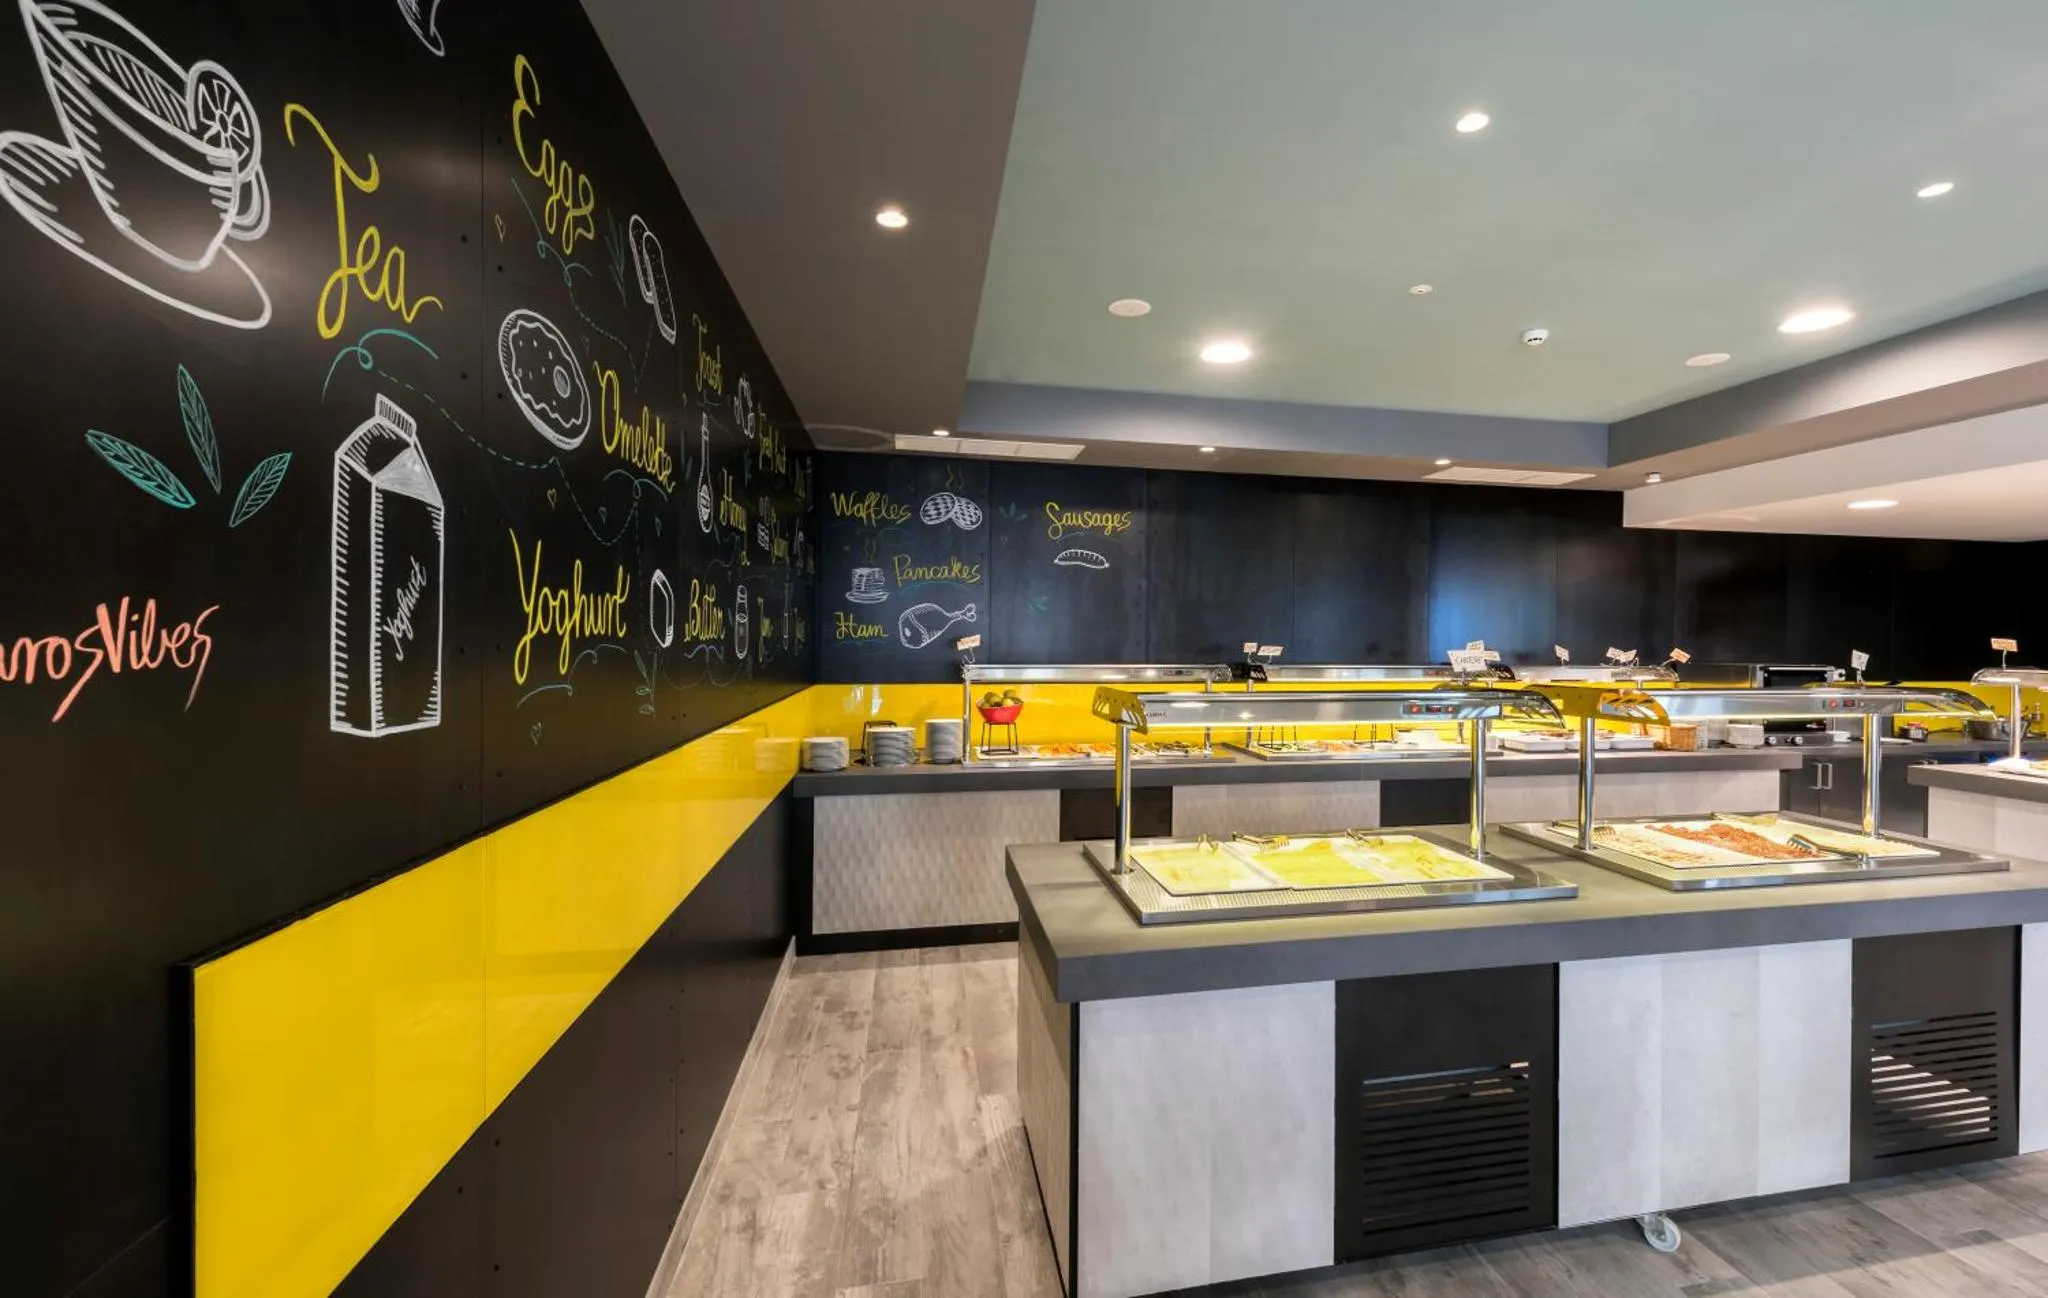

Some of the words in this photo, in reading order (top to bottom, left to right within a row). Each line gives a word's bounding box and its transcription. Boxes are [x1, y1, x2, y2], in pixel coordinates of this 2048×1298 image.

[513, 54, 595, 255] Eggs
[284, 104, 442, 339] Tea
[830, 490, 912, 526] Waffles
[1045, 501, 1132, 540] Sausages
[893, 553, 982, 587] Pancakes
[509, 527, 631, 686] Yoghurt
[833, 611, 889, 640] Ham
